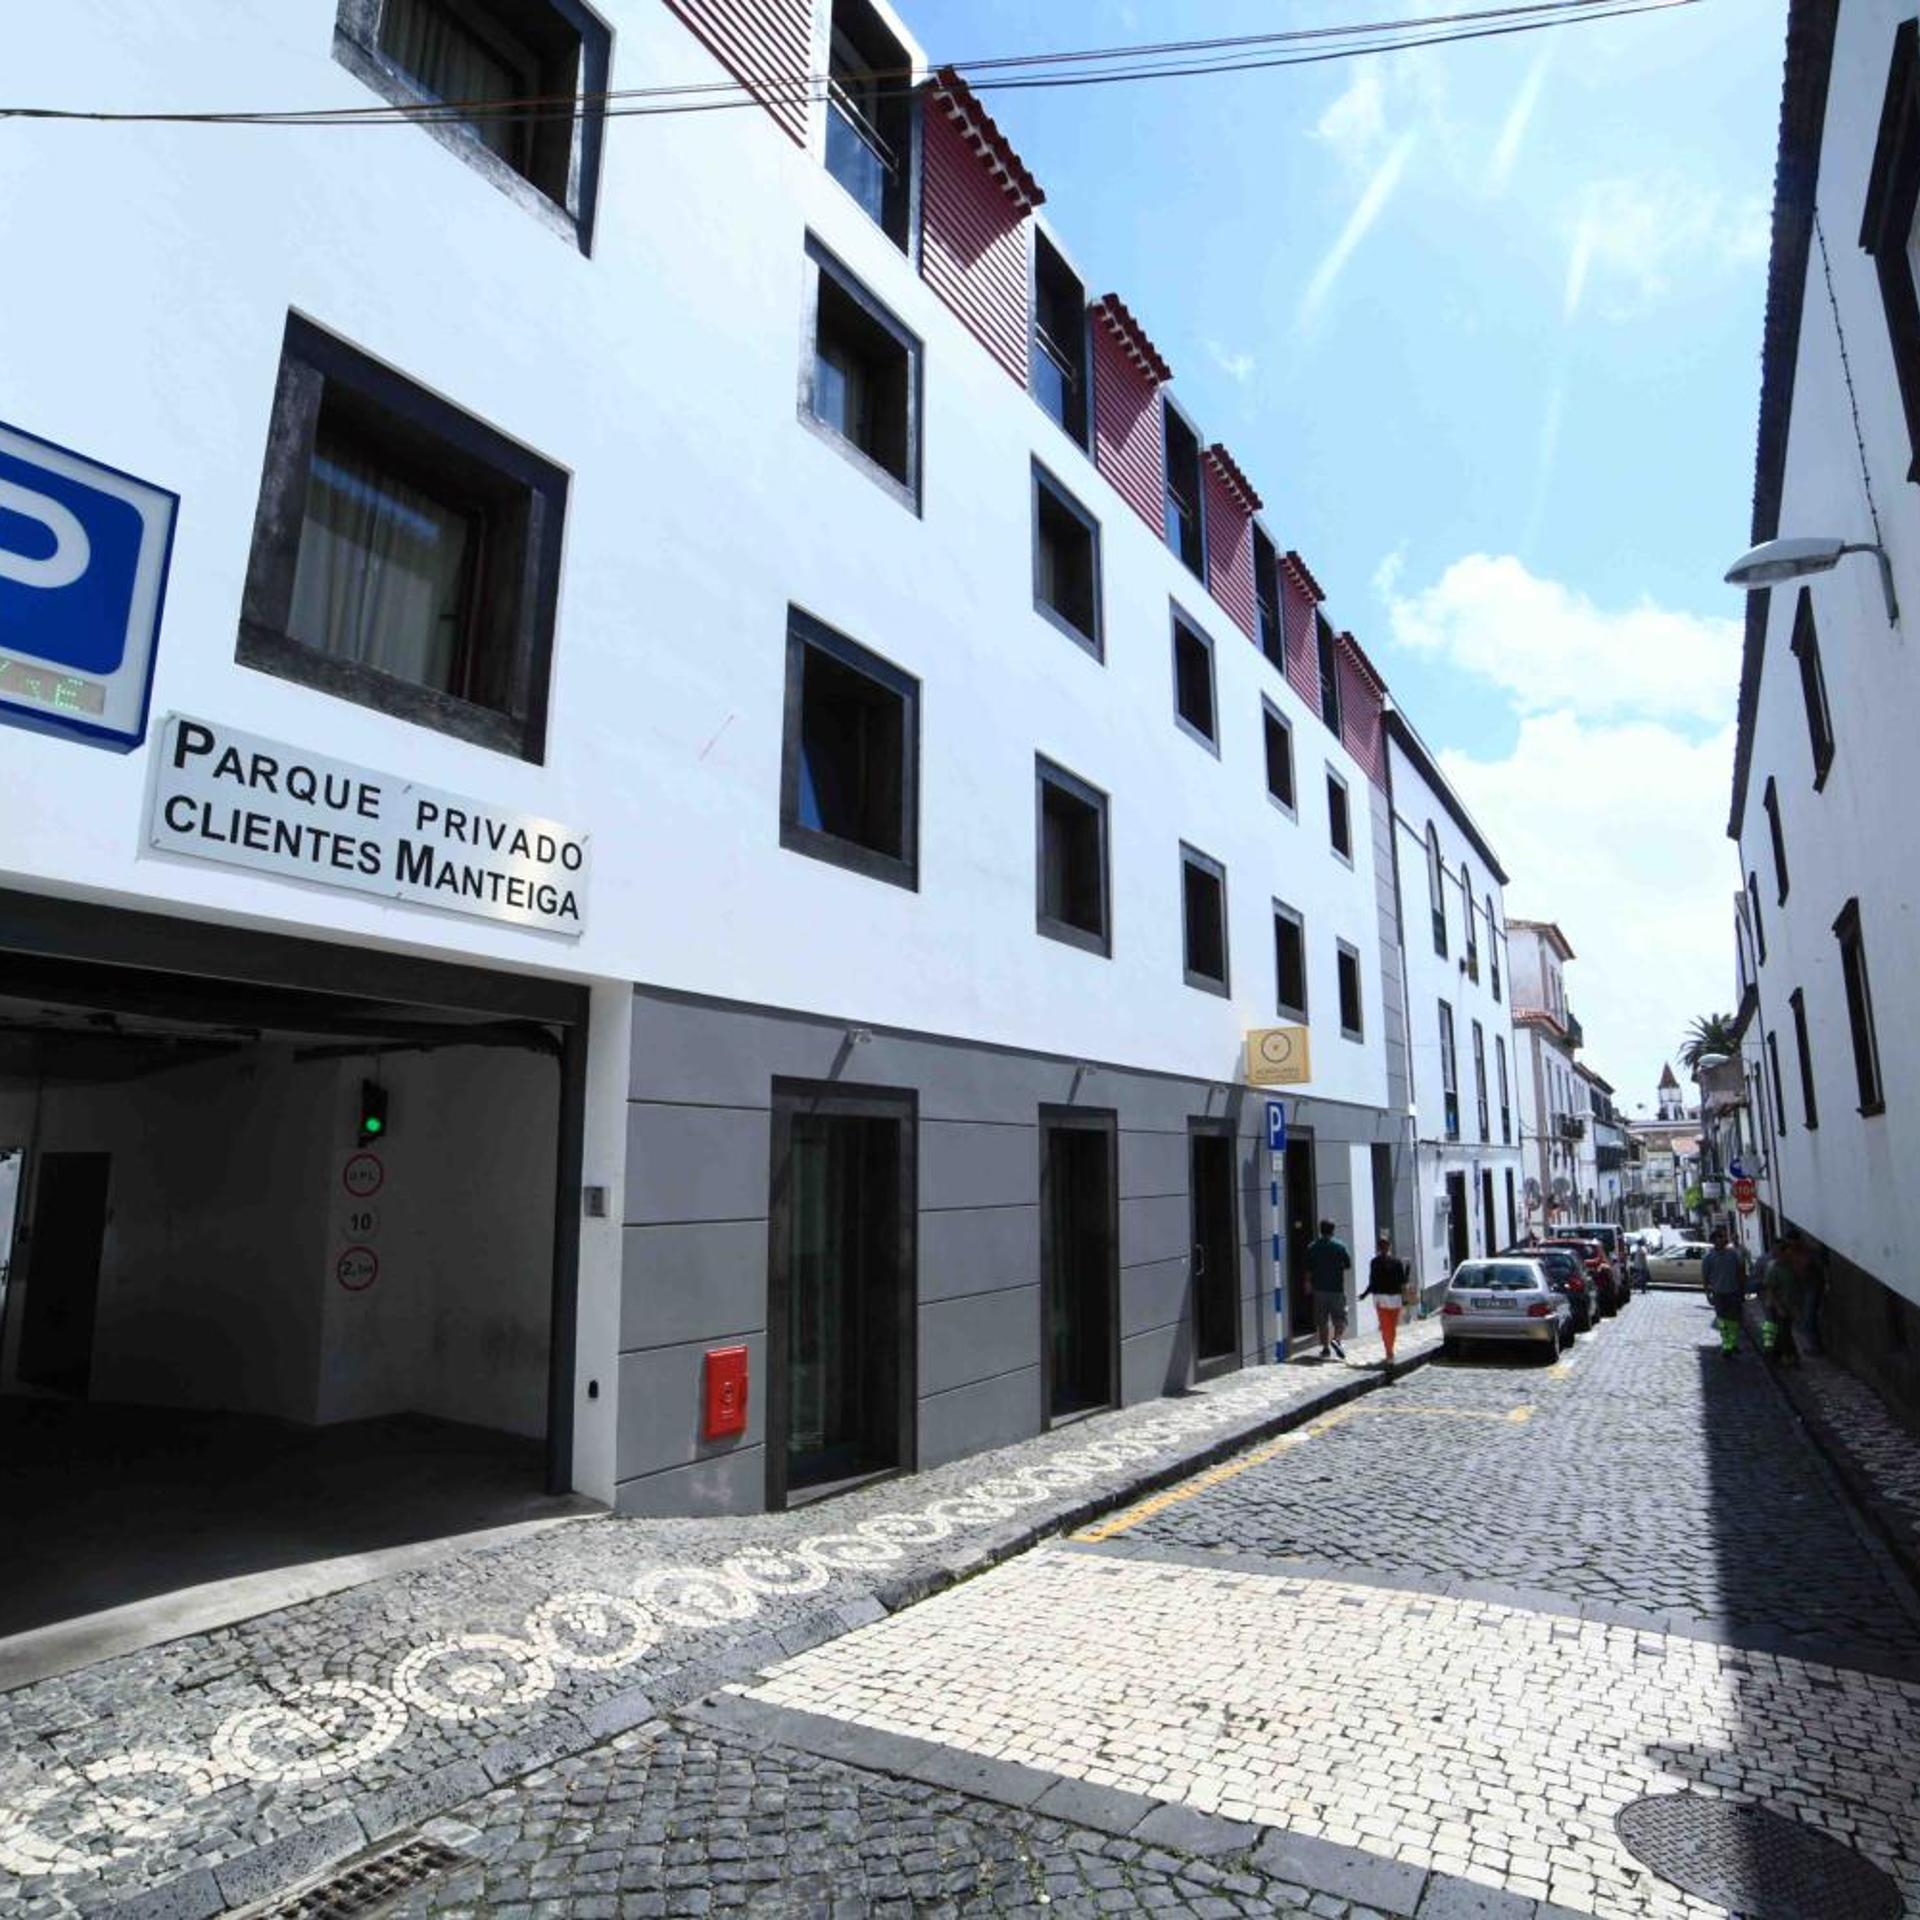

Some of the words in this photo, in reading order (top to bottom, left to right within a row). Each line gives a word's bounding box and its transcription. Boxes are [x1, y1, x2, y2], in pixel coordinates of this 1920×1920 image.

[171, 720, 382, 819] PARQUE
[416, 800, 584, 871] PRIVADO
[164, 794, 382, 875] CLIENTES
[395, 839, 580, 920] MANTEIGA
[1270, 1105, 1281, 1145] P
[351, 1212, 373, 1231] 10
